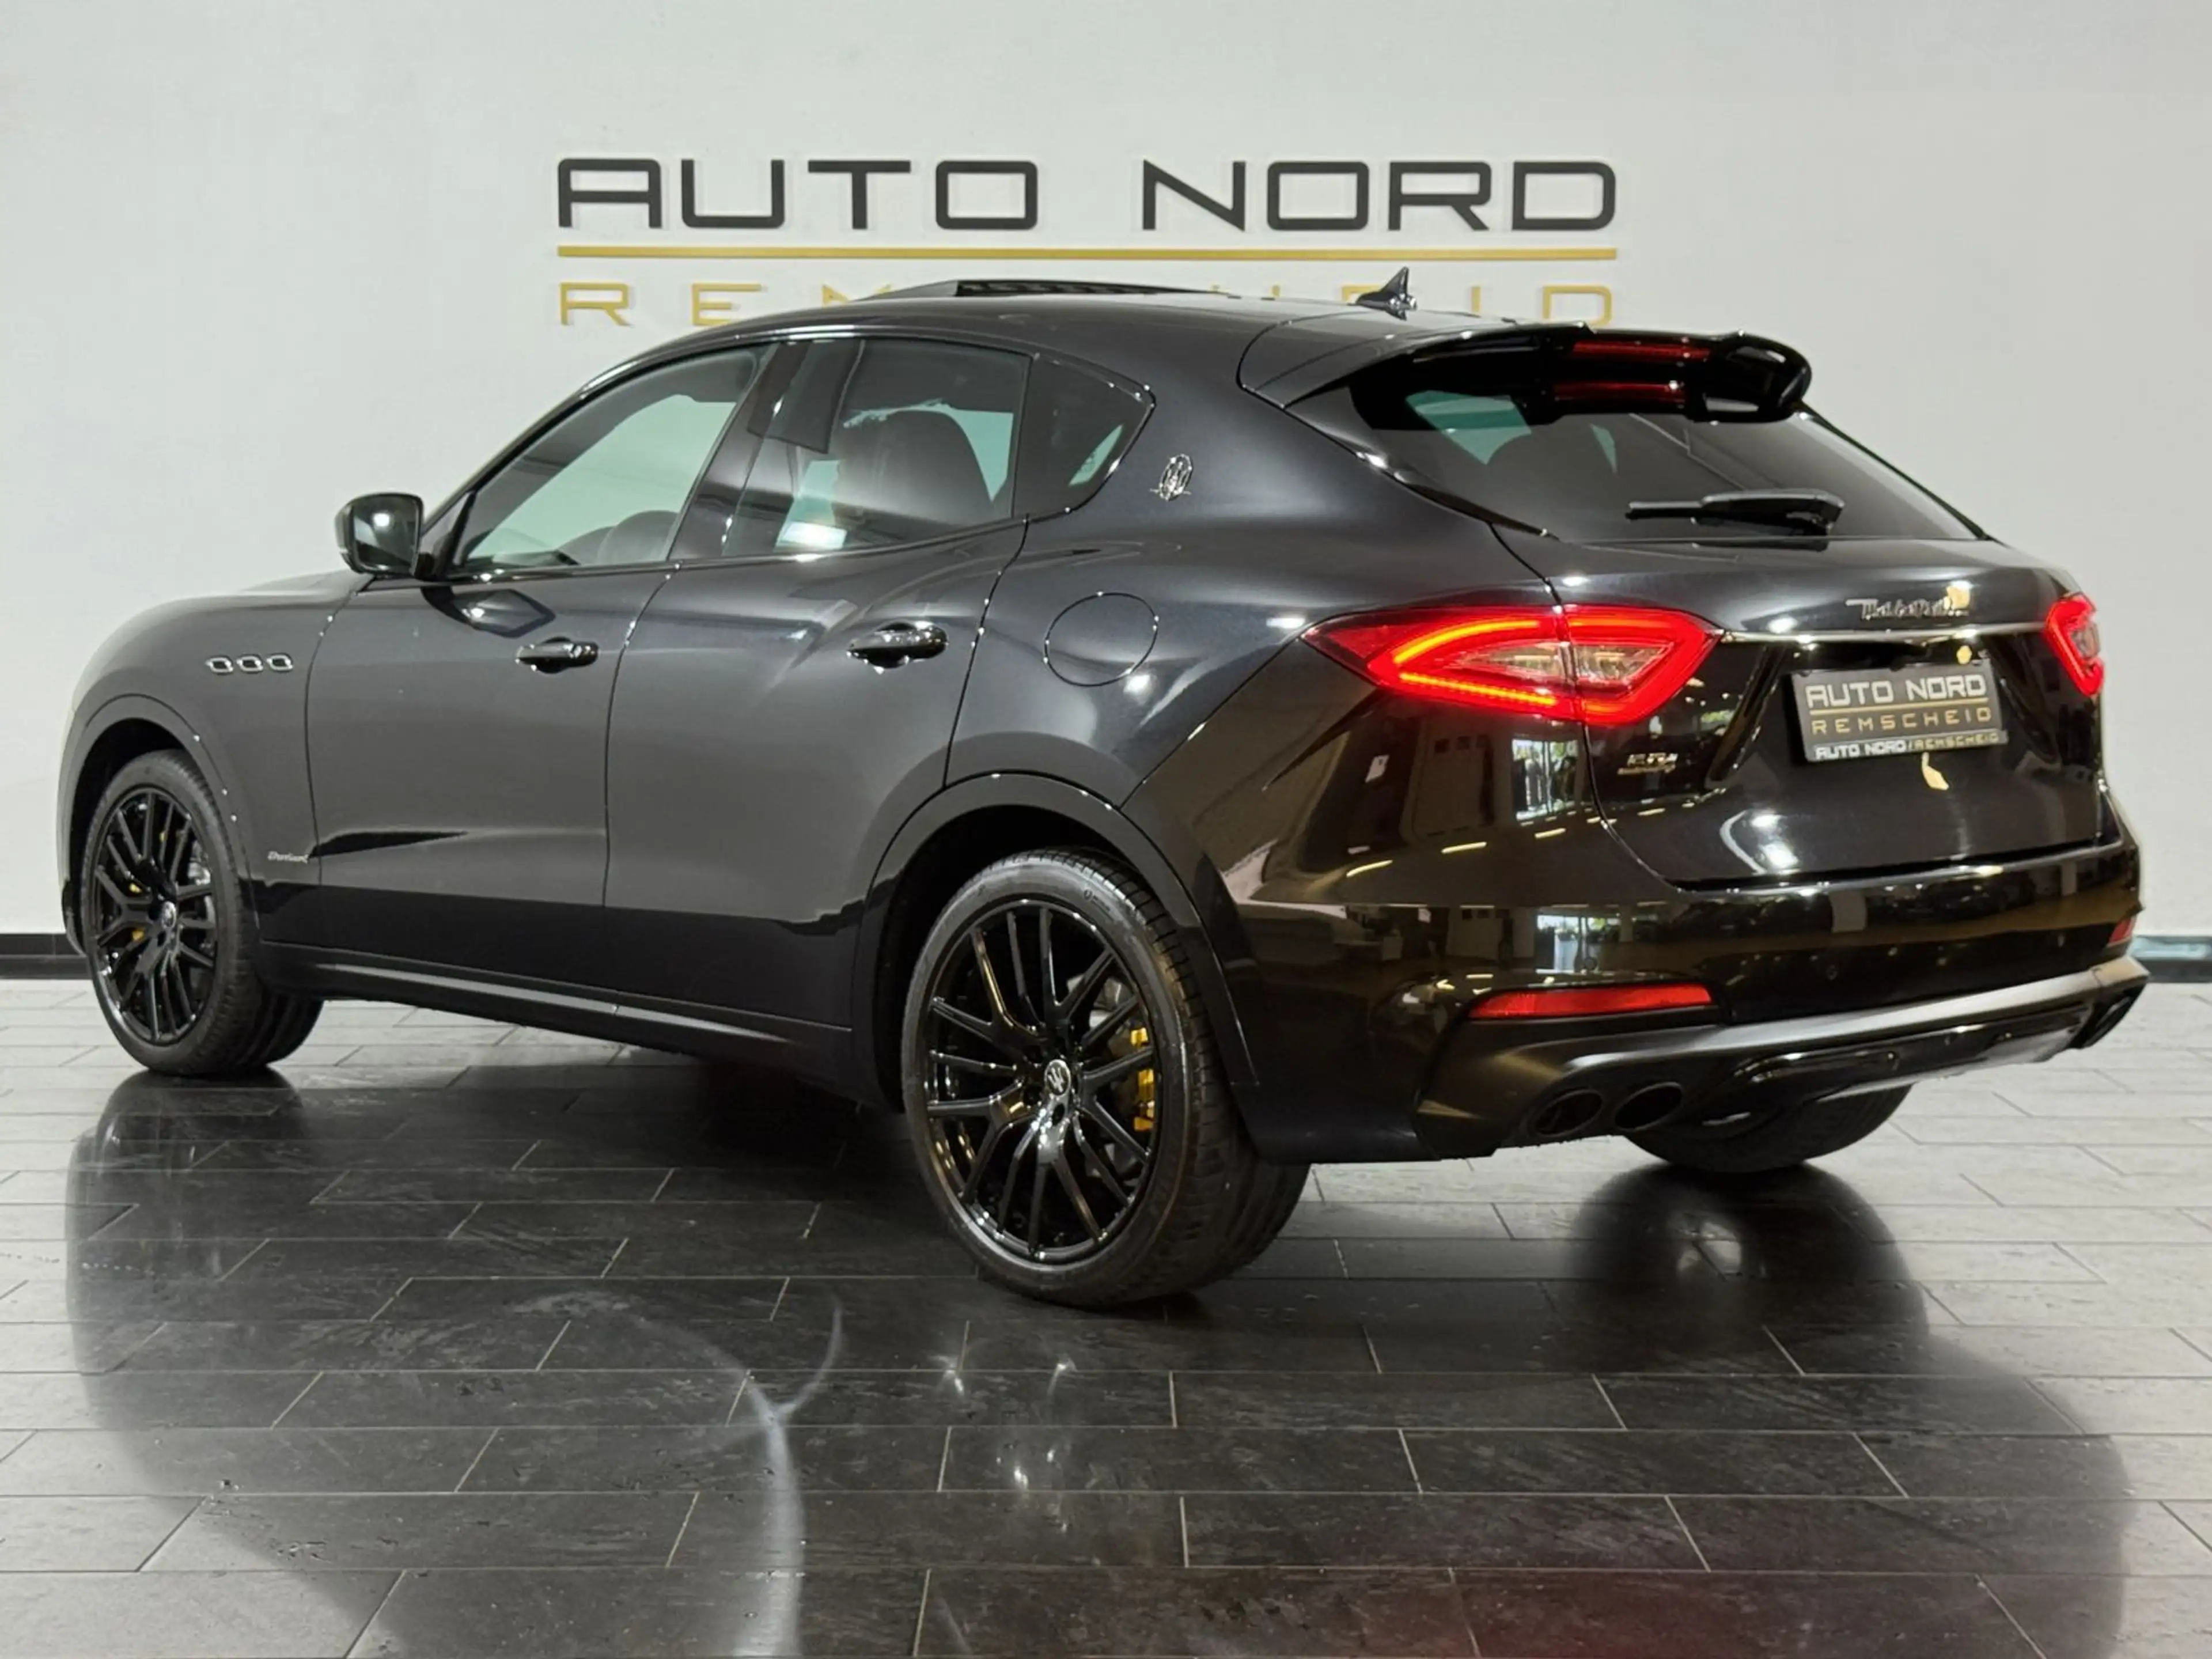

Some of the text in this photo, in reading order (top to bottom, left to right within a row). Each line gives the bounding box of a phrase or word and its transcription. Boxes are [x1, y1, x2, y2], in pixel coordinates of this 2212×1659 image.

[558, 158, 1616, 232] AUTO NORD
[1805, 673, 1987, 709] AUTO NORD
[1812, 707, 1992, 736] REMSCHEID
[1815, 743, 1861, 760] AUTO
